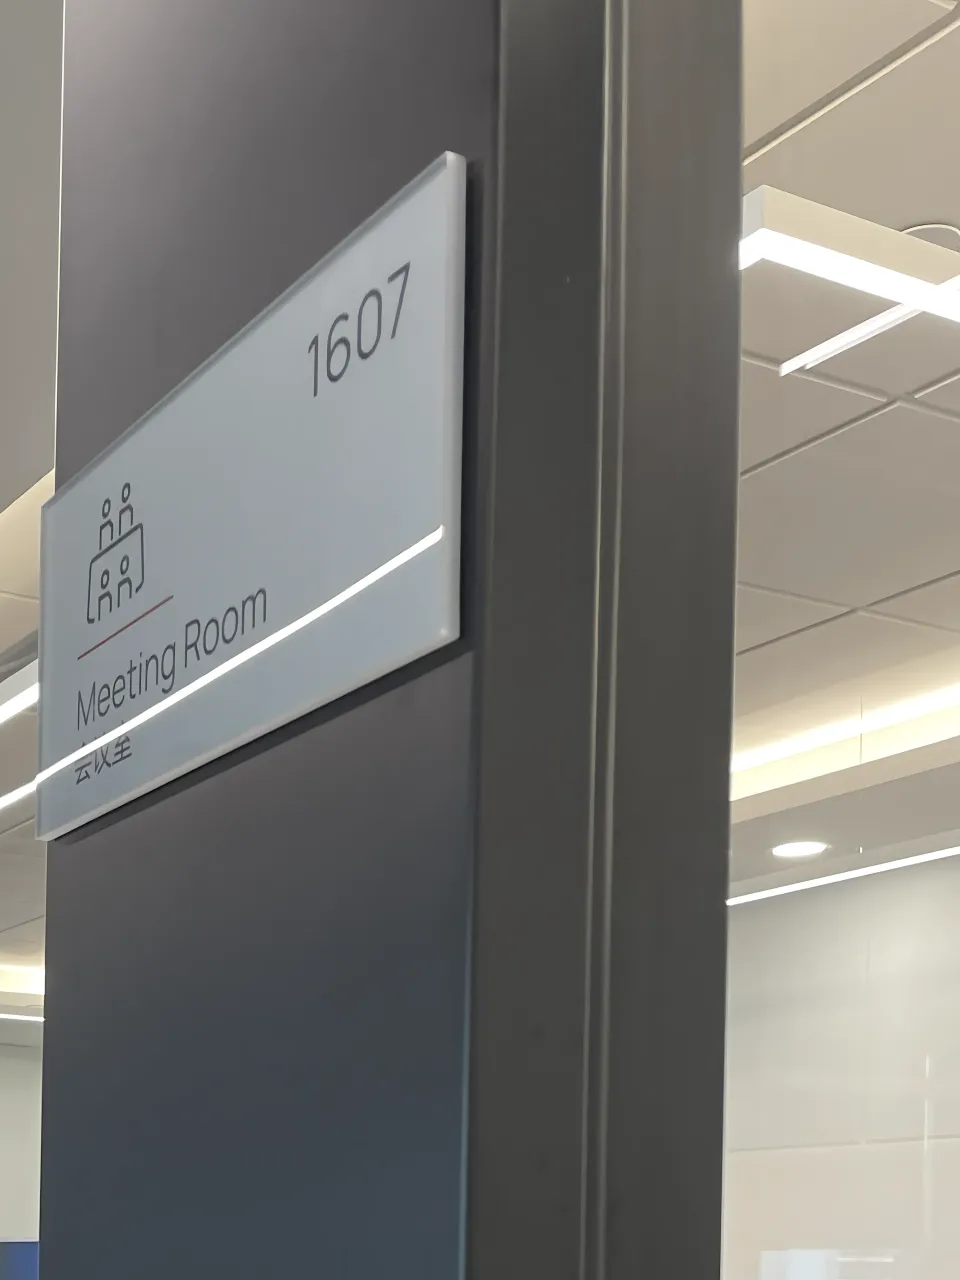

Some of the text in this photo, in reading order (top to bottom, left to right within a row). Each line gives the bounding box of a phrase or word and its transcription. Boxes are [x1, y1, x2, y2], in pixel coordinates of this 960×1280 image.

[308, 261, 411, 398] 1607
[77, 587, 267, 731] Meeting Room
